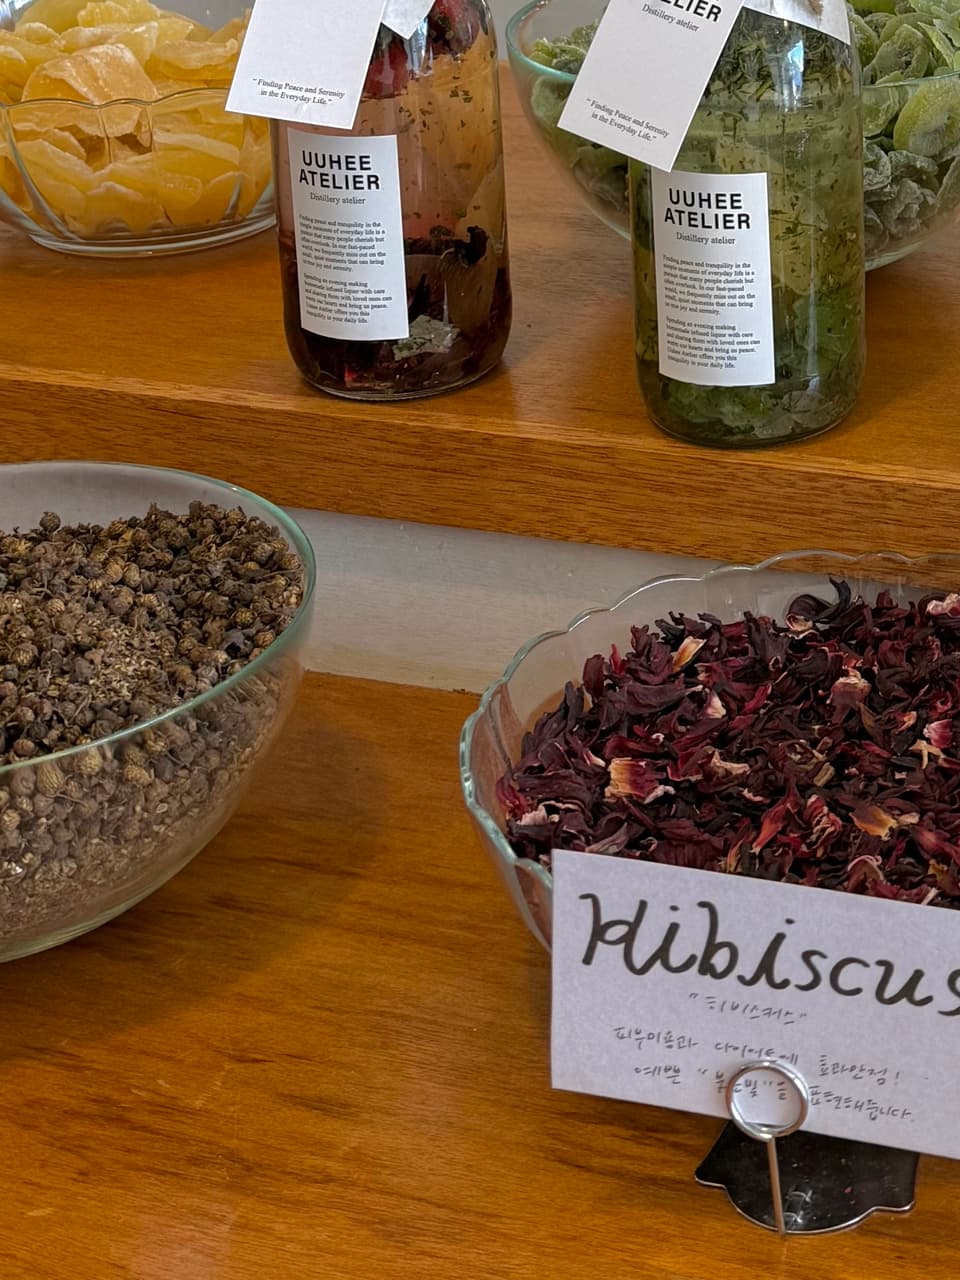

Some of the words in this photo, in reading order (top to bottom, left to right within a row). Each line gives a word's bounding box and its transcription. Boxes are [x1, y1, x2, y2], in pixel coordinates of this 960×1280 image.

[642, 4, 676, 24] Distillery
[676, 19, 699, 32] atelier
[280, 92, 311, 104] Everyday
[284, 83, 303, 92] Peace
[318, 88, 345, 99] Serenity
[592, 111, 599, 119] in
[599, 114, 609, 124] the
[609, 118, 637, 136] Everyday
[614, 110, 632, 122] Peace
[632, 119, 644, 127] and
[644, 122, 670, 138] Serenity
[302, 150, 371, 171] UUHEE
[299, 169, 380, 190] ATELIER
[310, 192, 340, 205] Distillery
[342, 196, 366, 205] atelier
[669, 188, 742, 209] UUHEE
[664, 208, 750, 230] ATELIER
[676, 232, 709, 245] Distillery
[711, 237, 736, 245] atelier
[613, 1026, 699, 1050] 피부미용과
[634, 1065, 681, 1084] 예쁜
